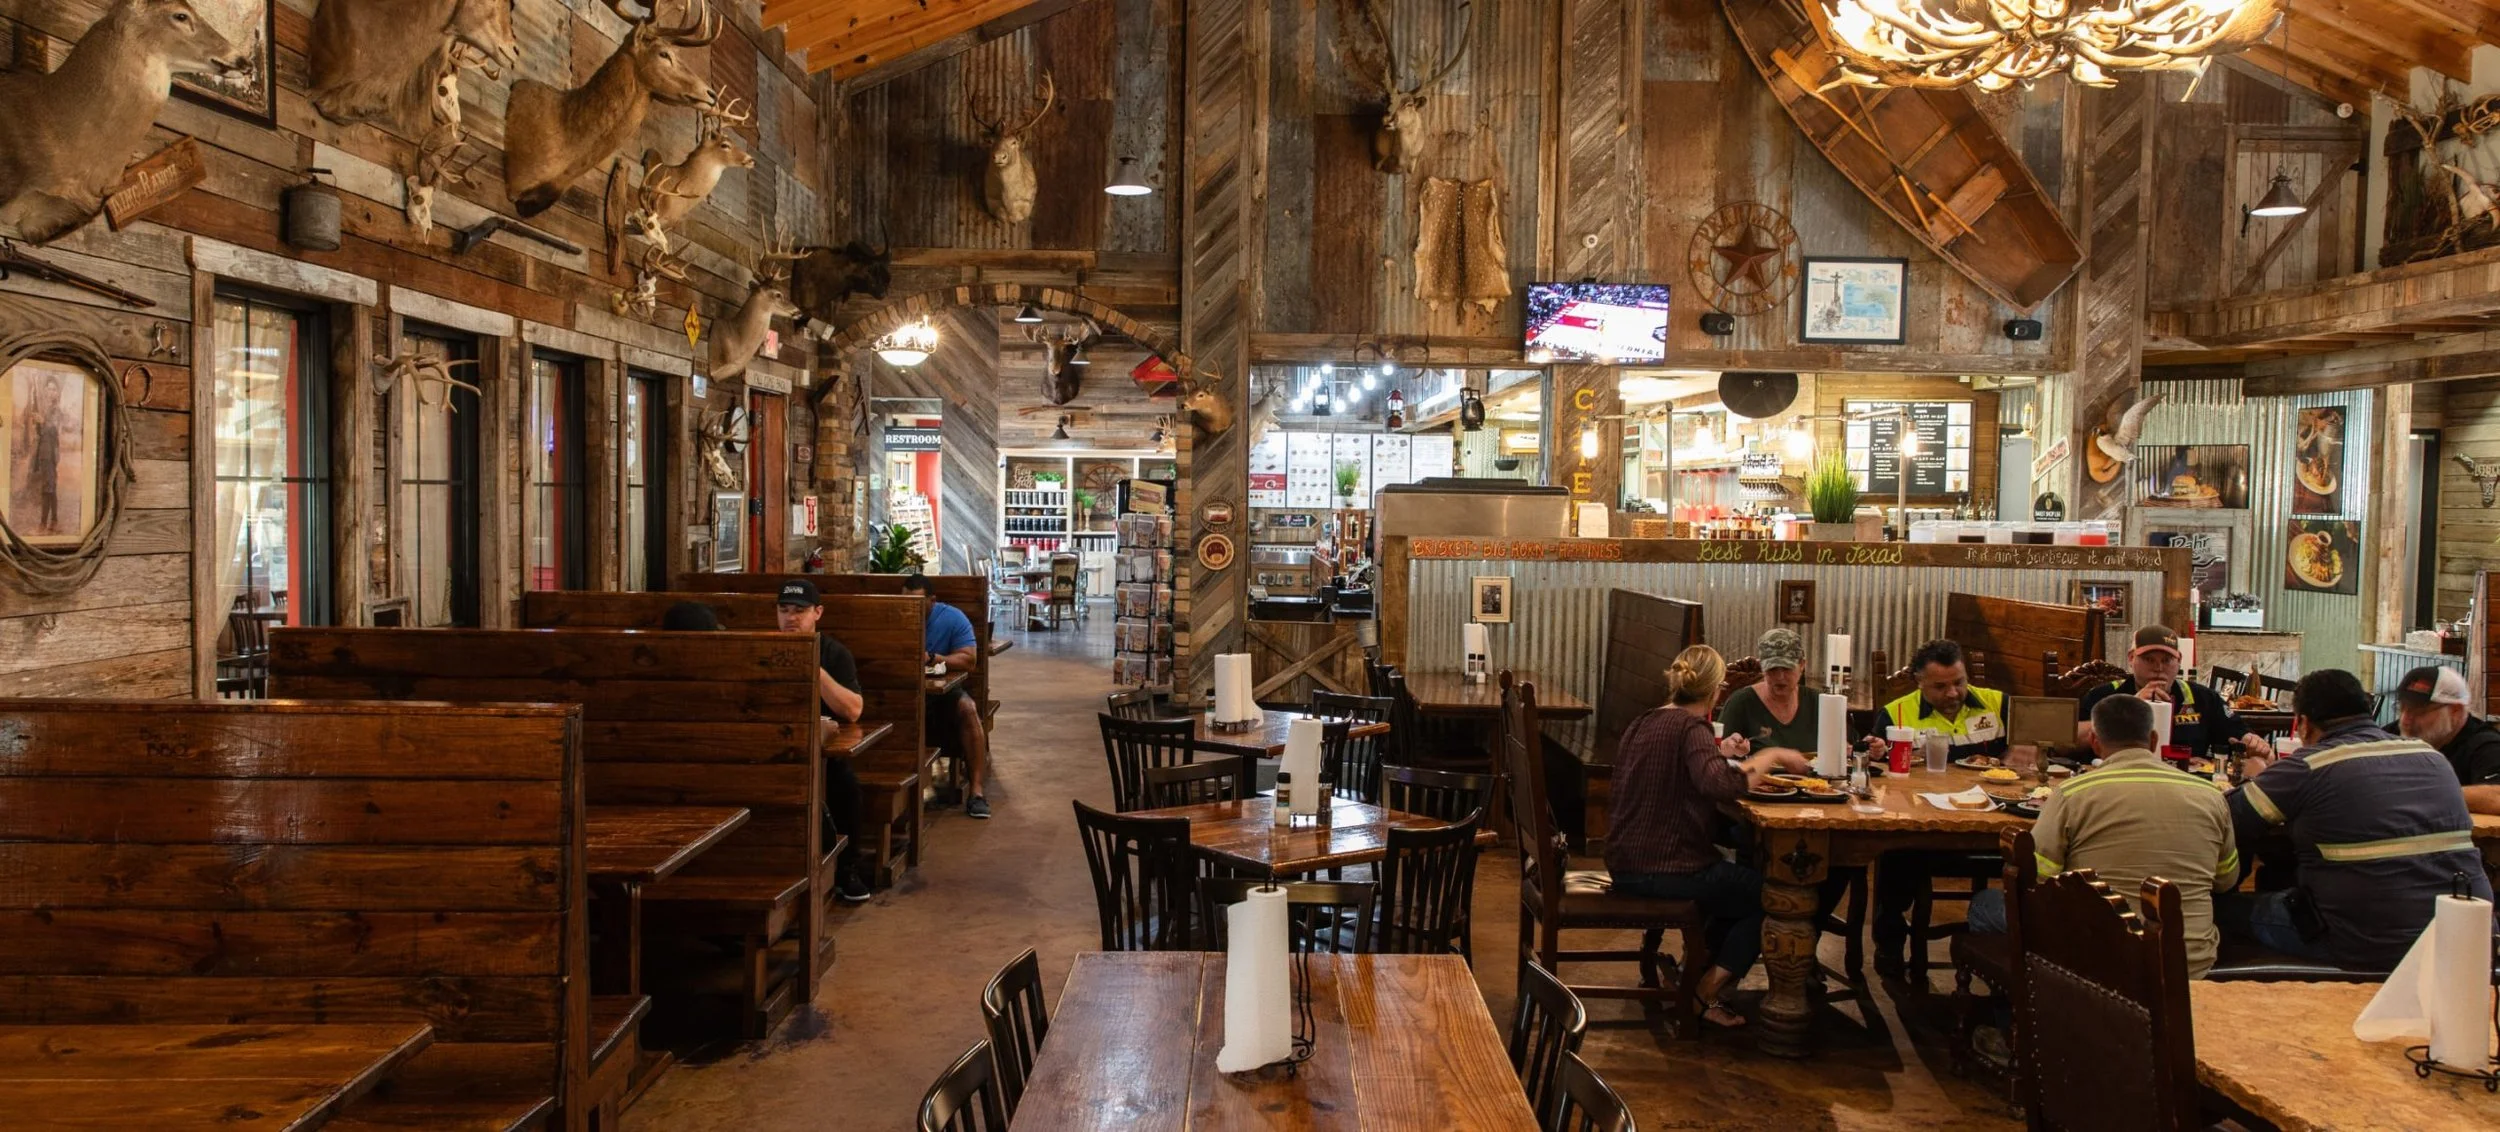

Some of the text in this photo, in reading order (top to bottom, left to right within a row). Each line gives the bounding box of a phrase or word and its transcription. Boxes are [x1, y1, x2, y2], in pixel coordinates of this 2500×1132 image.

[138, 163, 178, 197] RANCH
[885, 434, 942, 445] RESTROOM
[1412, 540, 1473, 557] BRISKET
[1483, 541, 1506, 557] BIG
[1511, 542, 1544, 559] HORN
[1559, 542, 1621, 559] HAPPINESS
[1697, 540, 1903, 564] Best Ribs in Texas
[2026, 548, 2079, 566] barbecue
[2088, 548, 2098, 565] it
[2134, 549, 2163, 567] food
[2175, 713, 2201, 722] TNT
